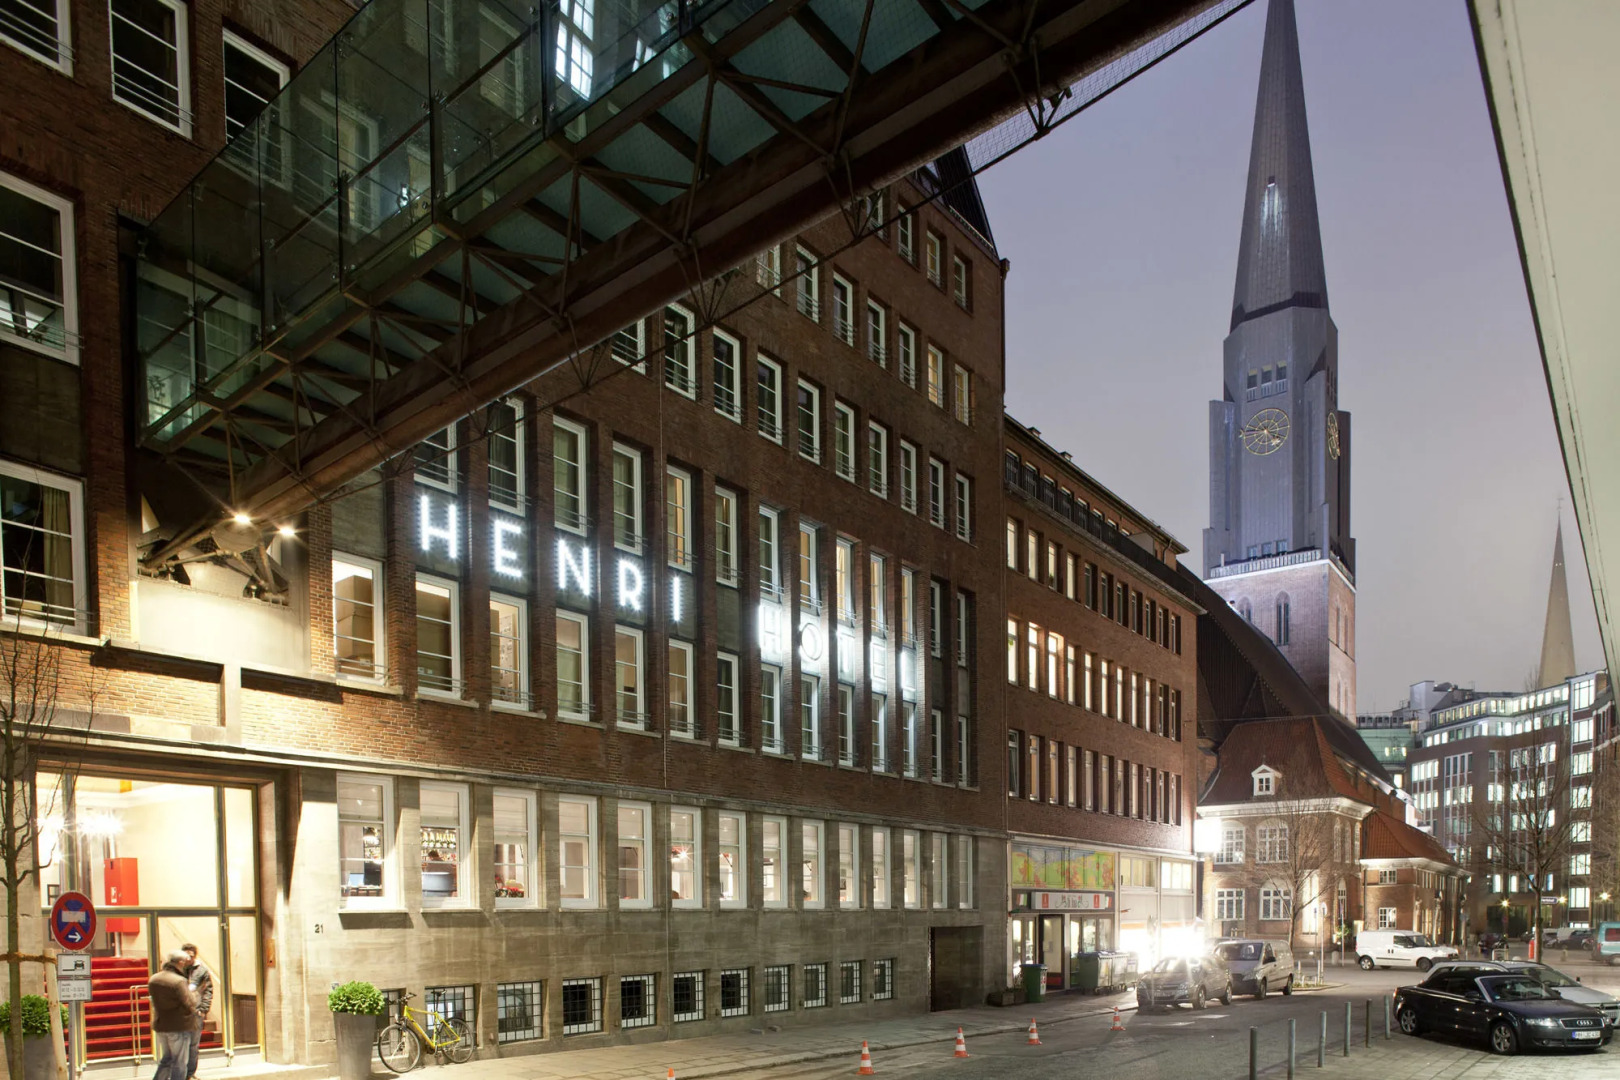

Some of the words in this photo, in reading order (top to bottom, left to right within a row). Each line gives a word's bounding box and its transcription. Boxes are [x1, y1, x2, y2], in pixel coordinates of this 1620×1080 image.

[419, 494, 682, 622] HENRI
[758, 603, 917, 692] HOTEL
[314, 923, 324, 934] 21
